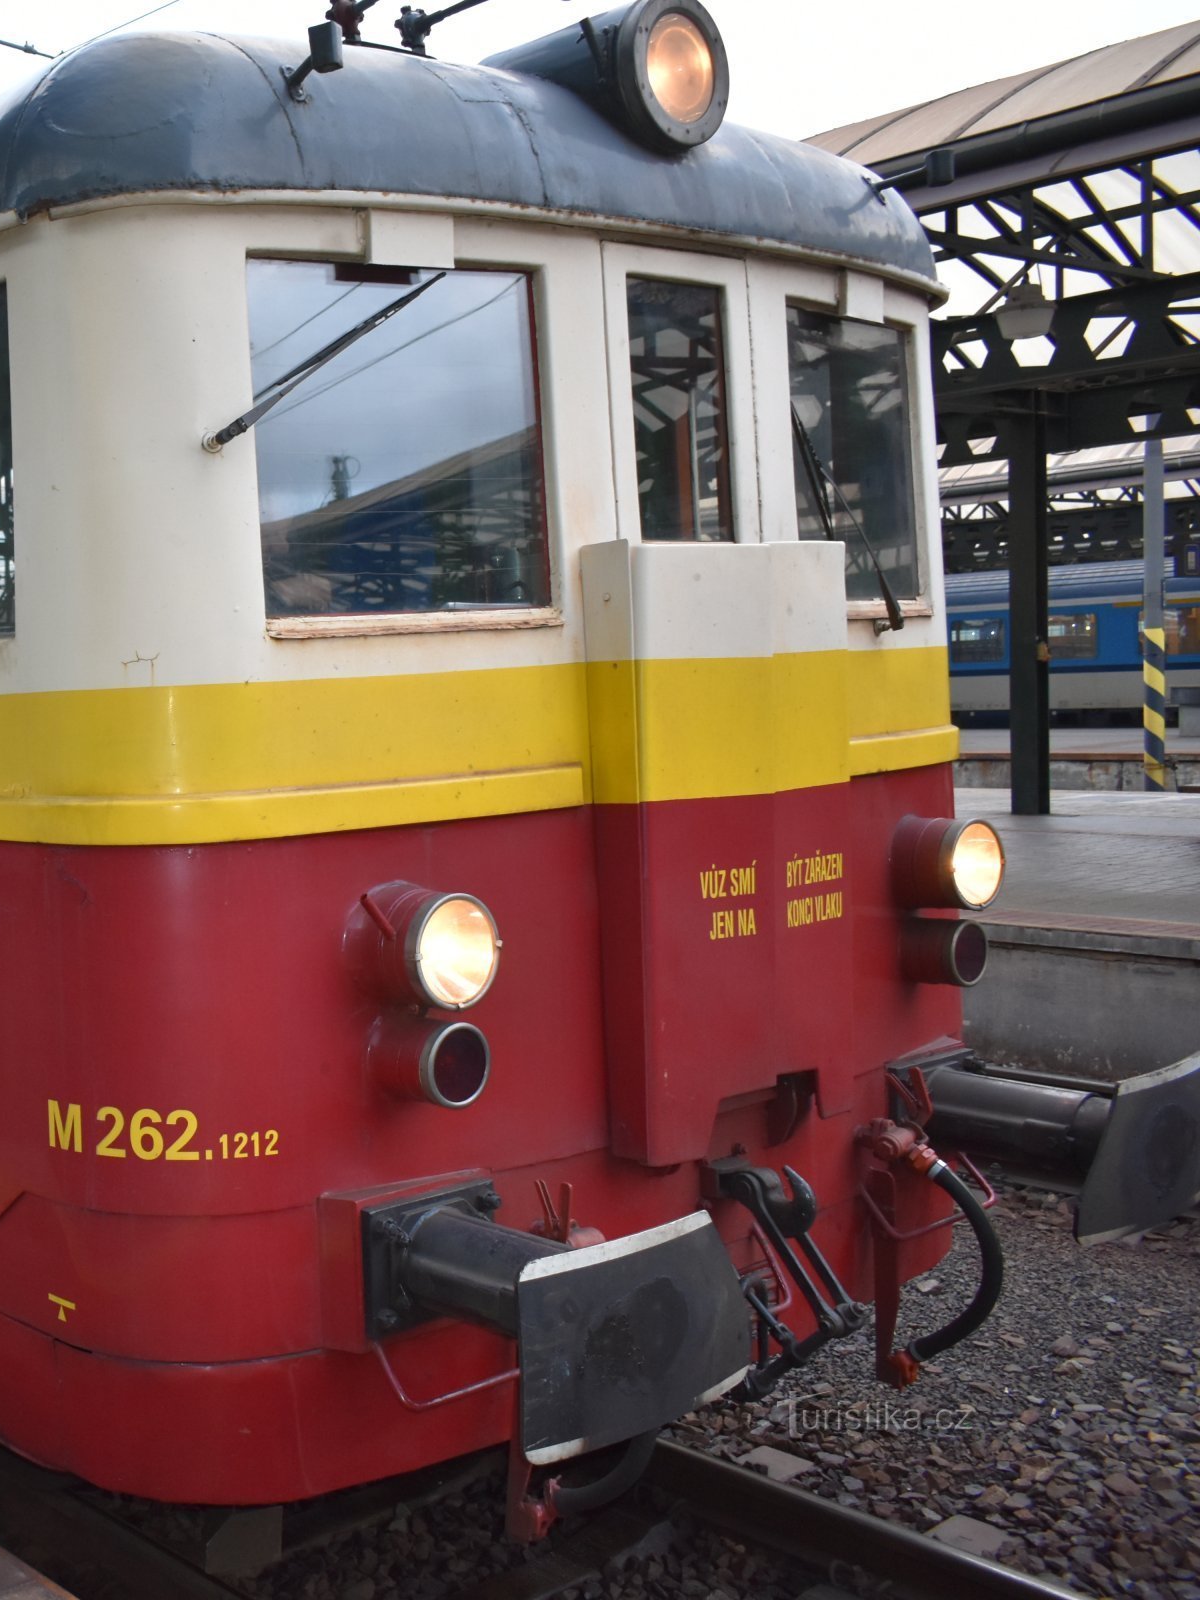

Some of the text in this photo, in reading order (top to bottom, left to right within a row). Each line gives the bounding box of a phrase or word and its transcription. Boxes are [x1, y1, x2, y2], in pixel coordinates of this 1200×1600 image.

[700, 849, 843, 899] VŮZ SMÍ BÝT ZAŘAZEN
[709, 891, 842, 940] JEN NA KONCI VLAKU
[48, 1099, 83, 1153] M
